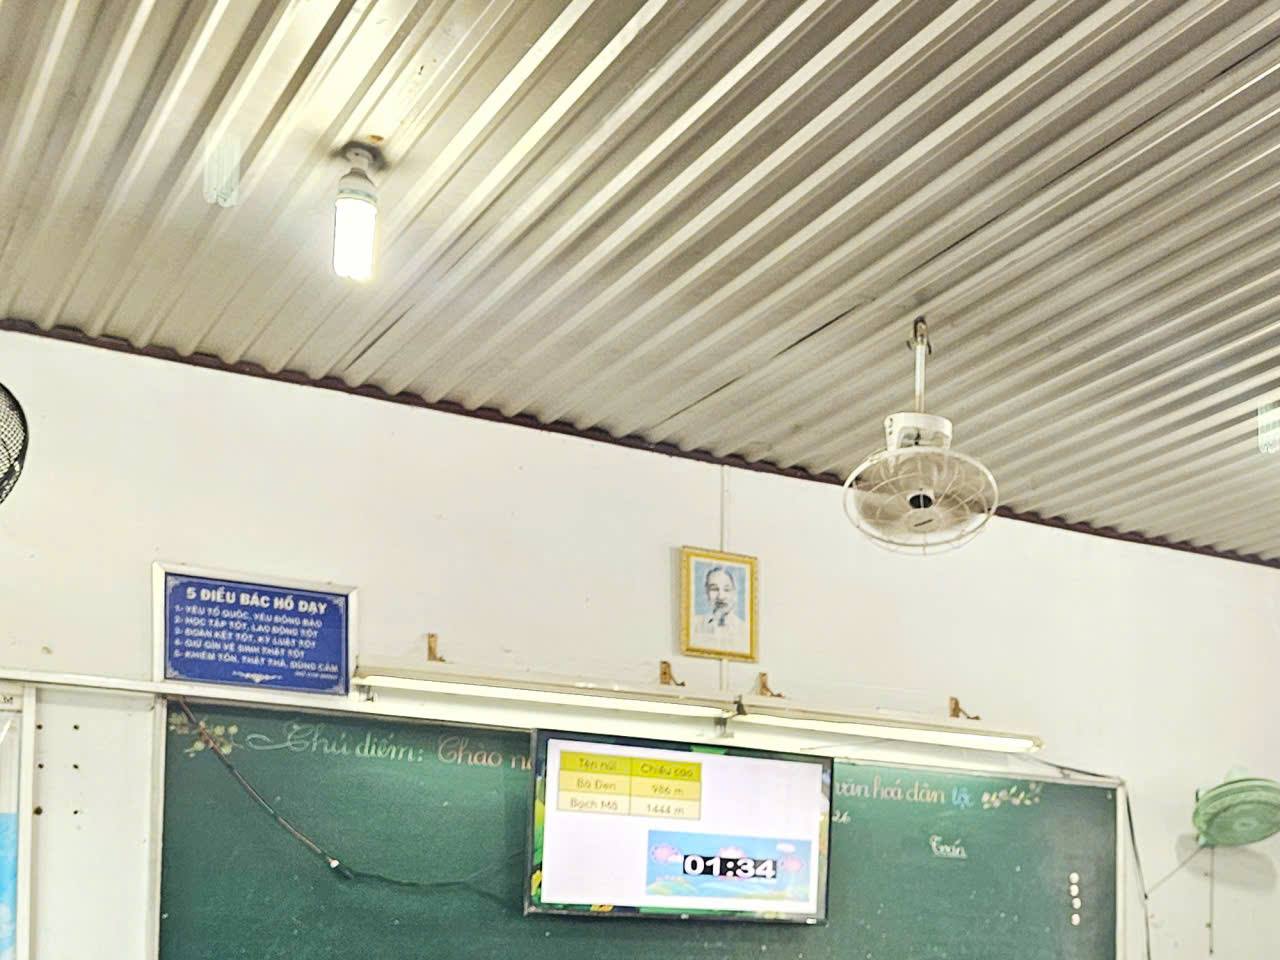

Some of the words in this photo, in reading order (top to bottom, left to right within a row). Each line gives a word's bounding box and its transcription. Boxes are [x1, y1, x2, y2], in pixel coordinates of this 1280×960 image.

[186, 586, 197, 600] 5
[240, 591, 270, 609] BÁC
[298, 599, 328, 616] DẠY
[684, 854, 775, 879] 01:34
